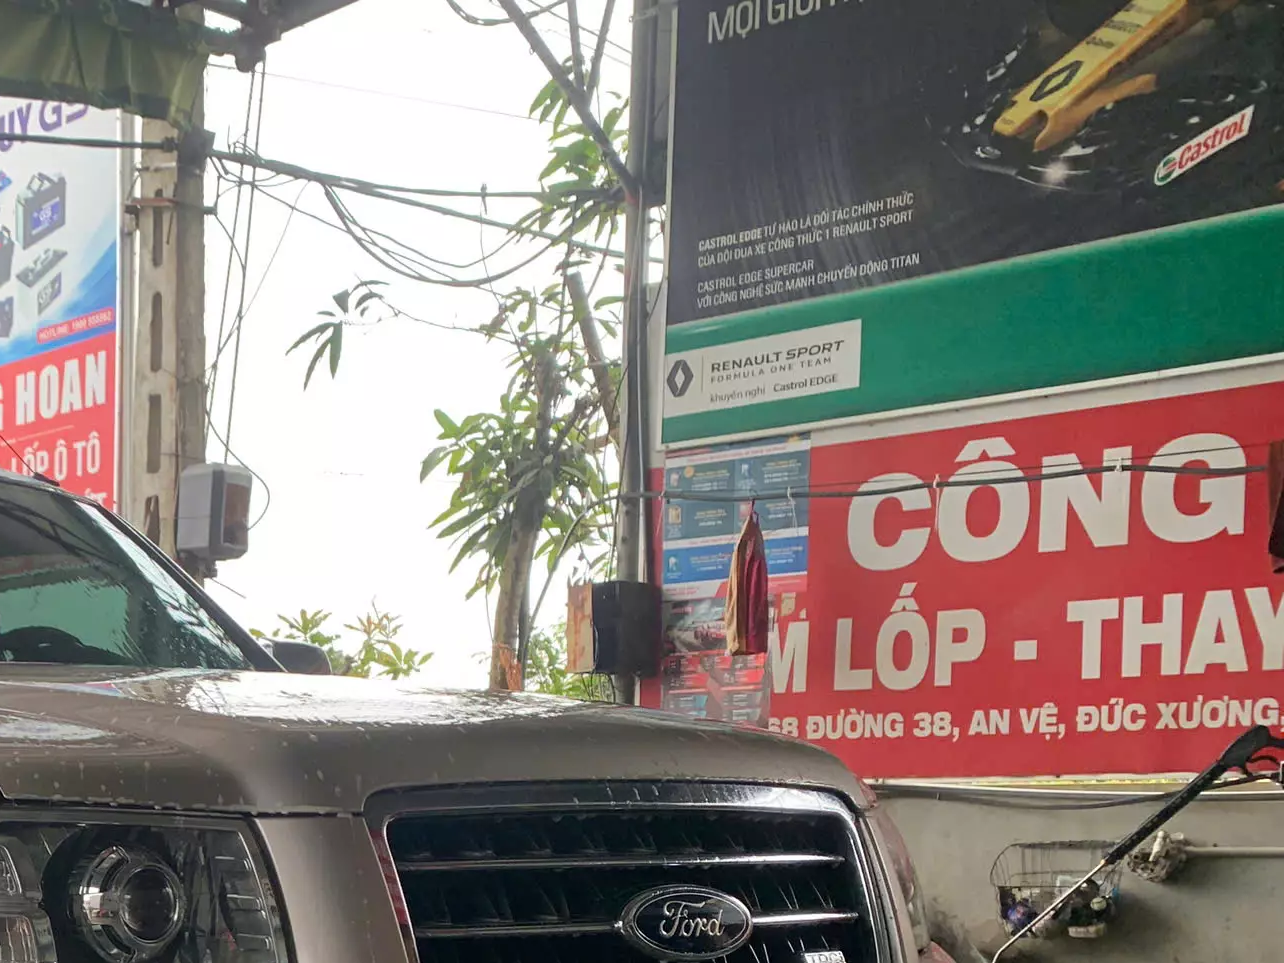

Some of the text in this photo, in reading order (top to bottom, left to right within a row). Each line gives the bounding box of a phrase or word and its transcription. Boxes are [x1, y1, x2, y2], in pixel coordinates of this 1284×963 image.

[708, 0, 761, 43] MỌI
[1177, 113, 1246, 169] Castrol
[698, 233, 738, 252] CASTROL
[739, 228, 763, 243] EDGE
[755, 242, 766, 255] XE
[832, 217, 878, 238] RENAULT
[879, 209, 914, 228] SPORT
[698, 259, 814, 293] CASTROL EDGE SUPERCAR
[890, 252, 920, 269] TITAN
[711, 340, 844, 373] RENAULT SPORT
[711, 356, 832, 384] FORMULA ONE TEAM
[16, 351, 107, 426] HOAN
[773, 379, 807, 393] Castrol
[809, 374, 838, 387] EDGE
[54, 439, 68, 480] Ô
[73, 431, 101, 477] TÔ
[847, 433, 1247, 572] CÔNG
[833, 582, 987, 692] LỐP
[1066, 586, 1284, 681] THAY
[806, 708, 904, 739] ĐƯỜNG
[913, 711, 959, 742] 38,
[968, 709, 1011, 736] AN
[1019, 702, 1066, 740] VỆ,
[1076, 697, 1147, 732] ĐỨC
[659, 899, 725, 938] Ford
